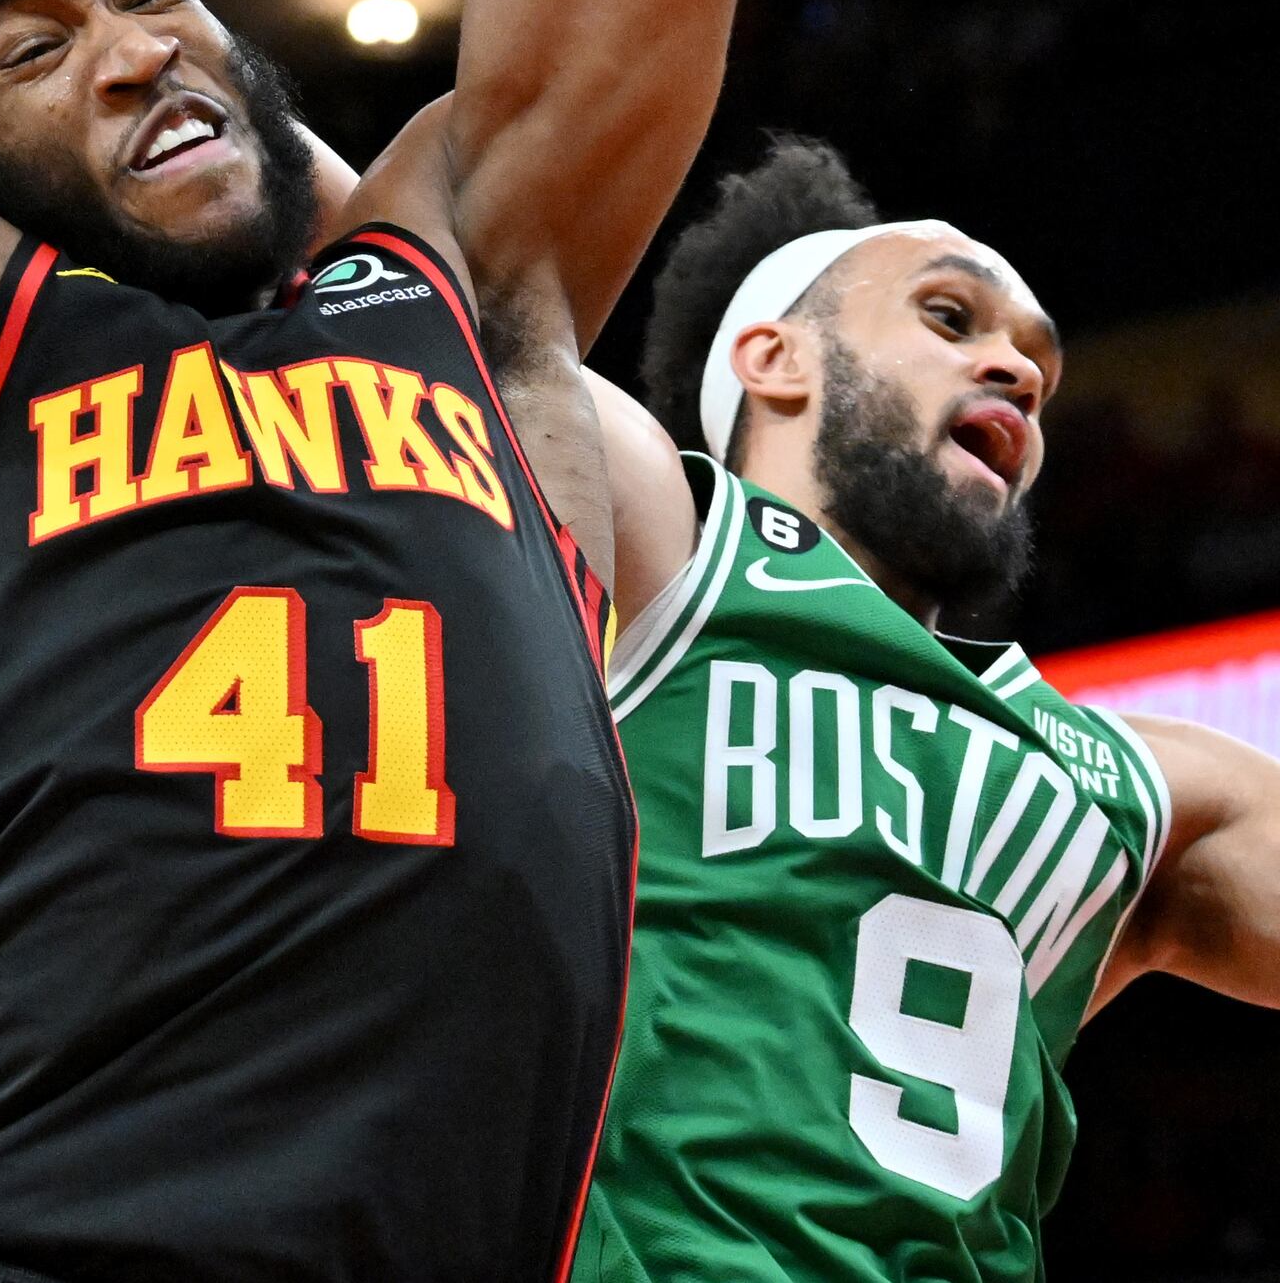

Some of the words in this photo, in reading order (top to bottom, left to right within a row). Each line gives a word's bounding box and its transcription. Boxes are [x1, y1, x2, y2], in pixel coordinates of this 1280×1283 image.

[319, 284, 431, 315] sharecare
[28, 340, 513, 546] HAWKS
[762, 507, 800, 549] 6
[135, 586, 456, 847] 41
[1034, 707, 1119, 774] VISTA
[1069, 763, 1120, 798] INT
[702, 659, 1129, 1000] BOSTON
[849, 893, 1026, 1201] 9
